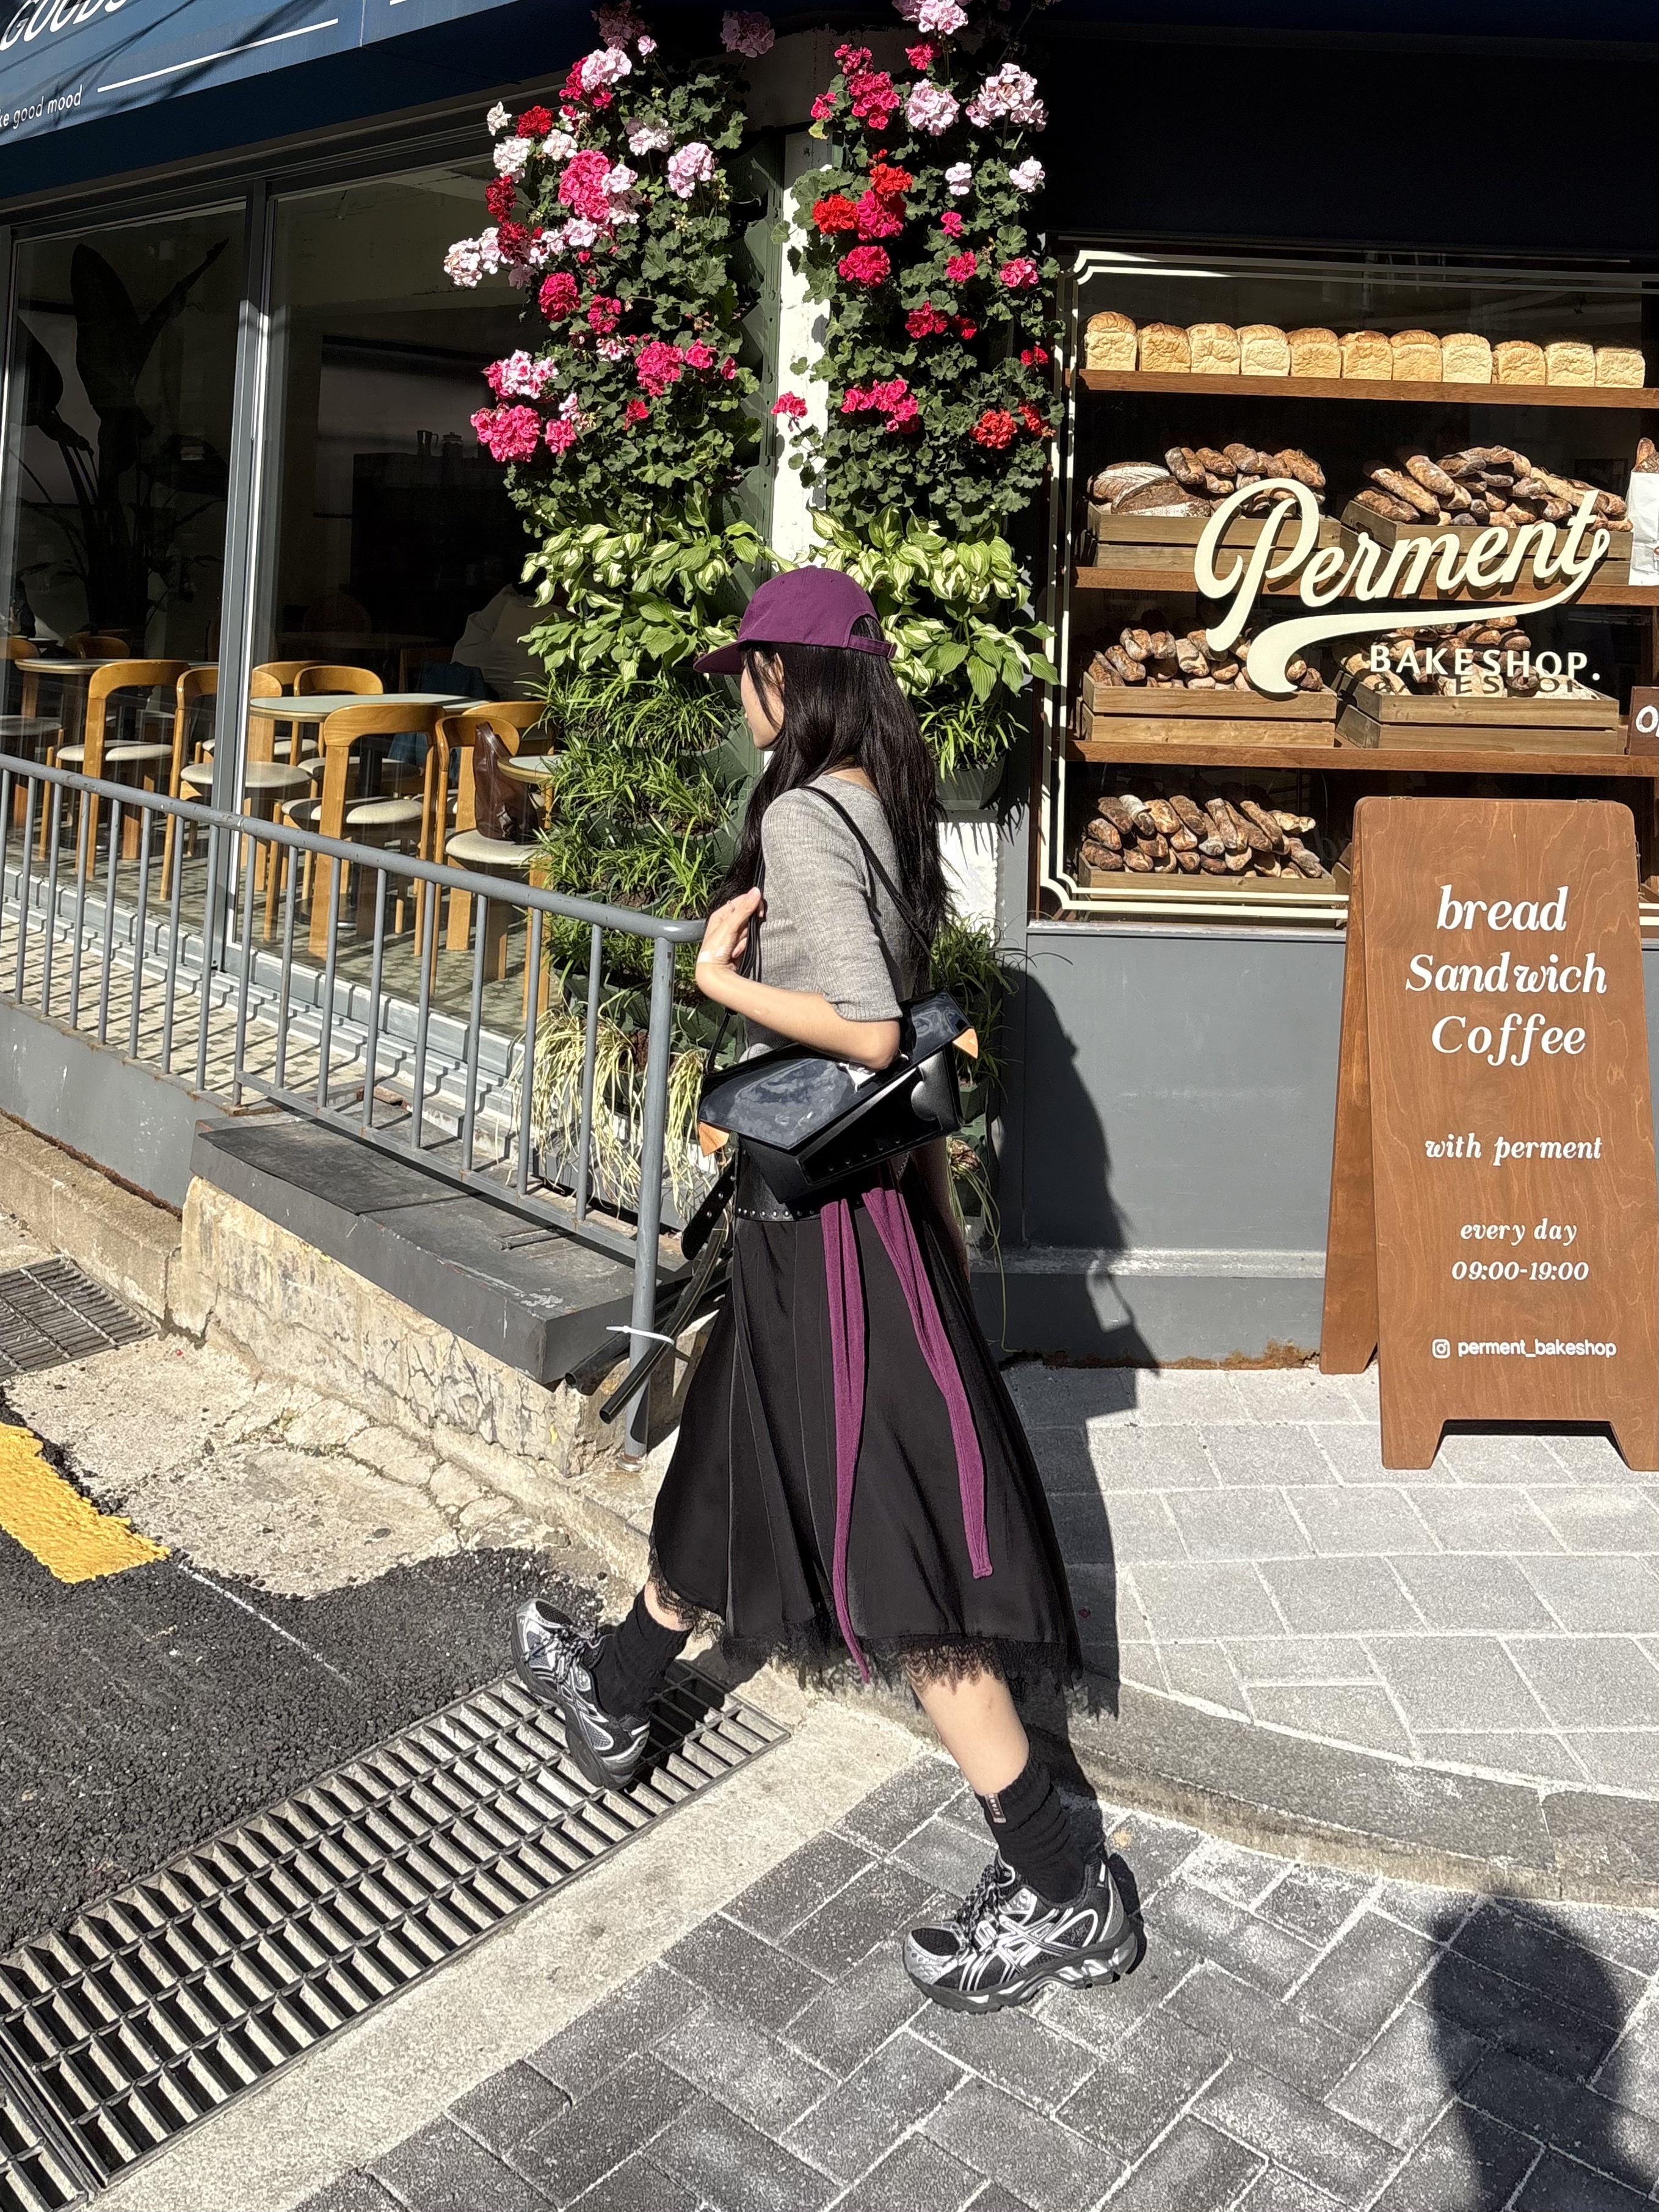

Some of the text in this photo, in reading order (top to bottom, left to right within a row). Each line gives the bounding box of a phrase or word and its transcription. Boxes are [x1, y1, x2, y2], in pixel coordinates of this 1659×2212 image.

[0, 0, 127, 51] GOO
[13, 96, 44, 129] good
[48, 84, 82, 114] mood
[1194, 478, 1608, 692] Perment
[1635, 705, 1659, 738] O
[1437, 884, 1569, 931] bread
[1406, 951, 1607, 994] Sandwich
[1432, 1013, 1586, 1066] Coffee
[1425, 1133, 1603, 1166] with perment
[1460, 1218, 1577, 1247] every day
[1451, 1261, 1589, 1280] 09:00-19:00
[1458, 1338, 1617, 1358] perment_bakeshop
